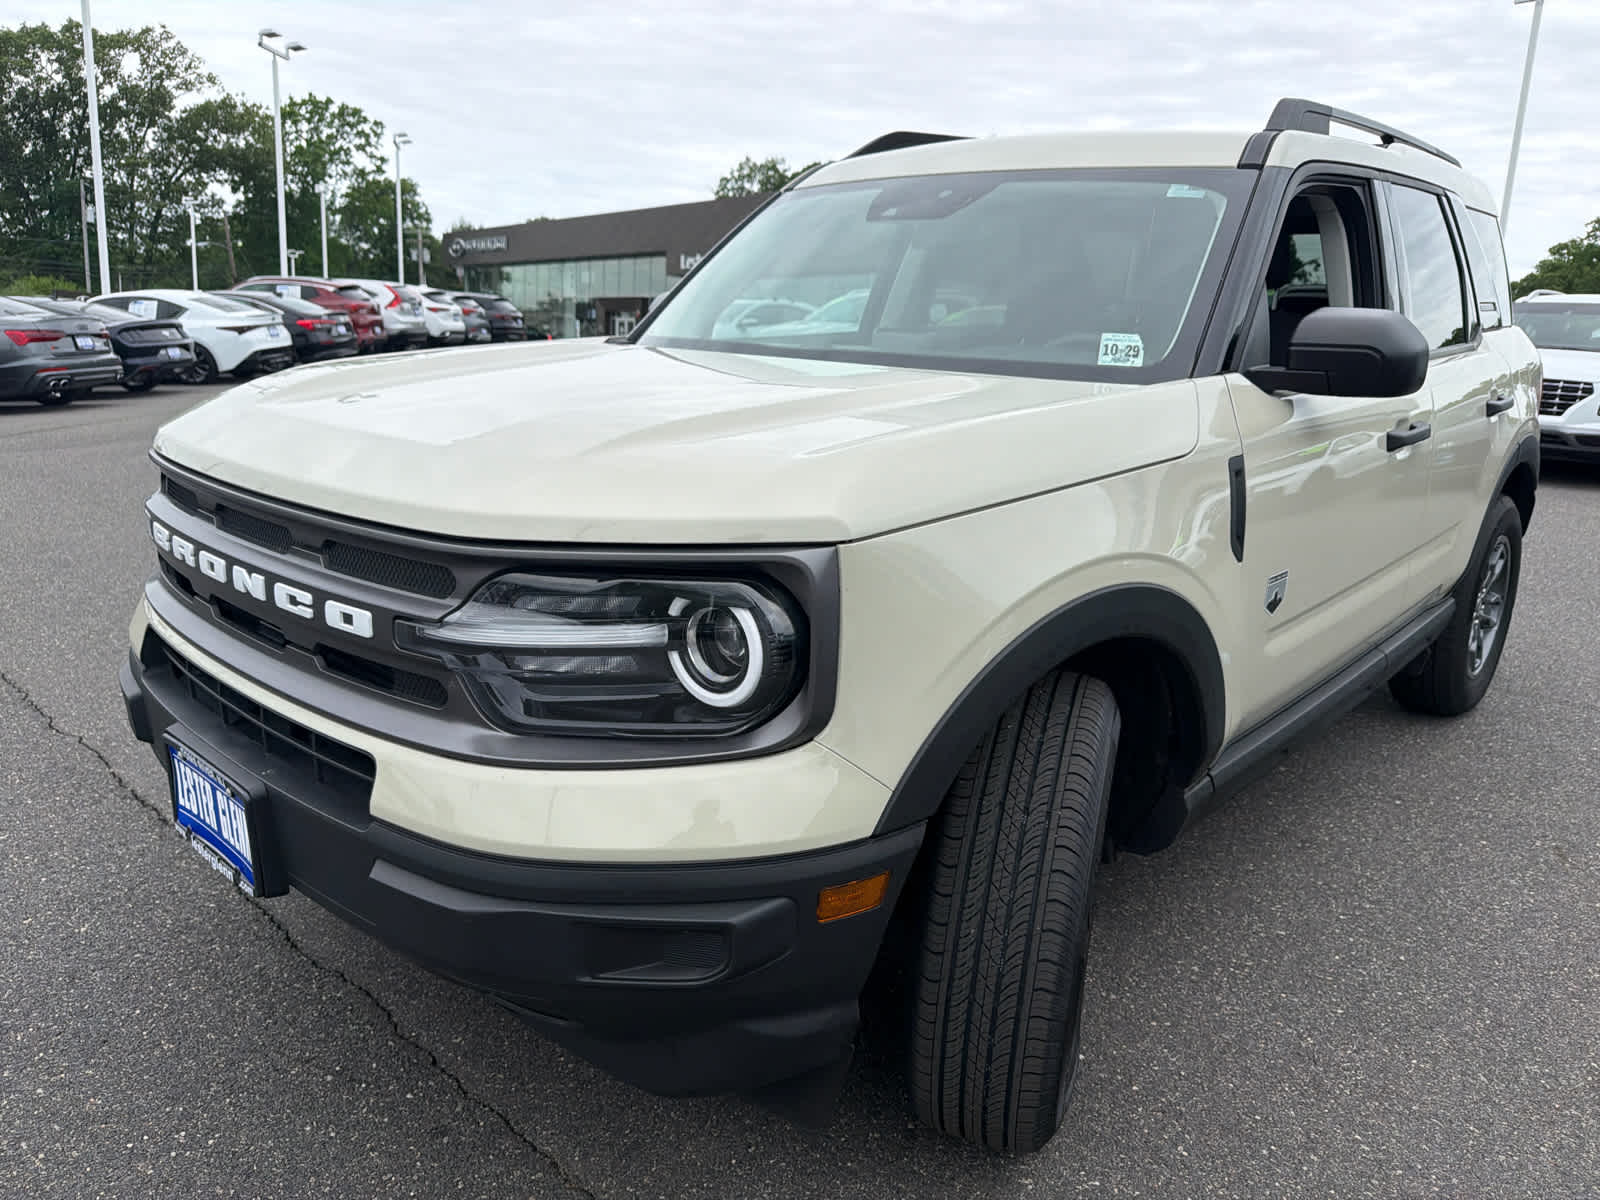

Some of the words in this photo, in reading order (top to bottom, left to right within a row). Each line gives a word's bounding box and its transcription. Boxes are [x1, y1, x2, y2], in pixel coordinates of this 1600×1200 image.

[1103, 343, 1118, 356] 10
[1125, 344, 1140, 358] 29
[152, 521, 374, 638] BRONCO
[174, 757, 218, 831] LESTER
